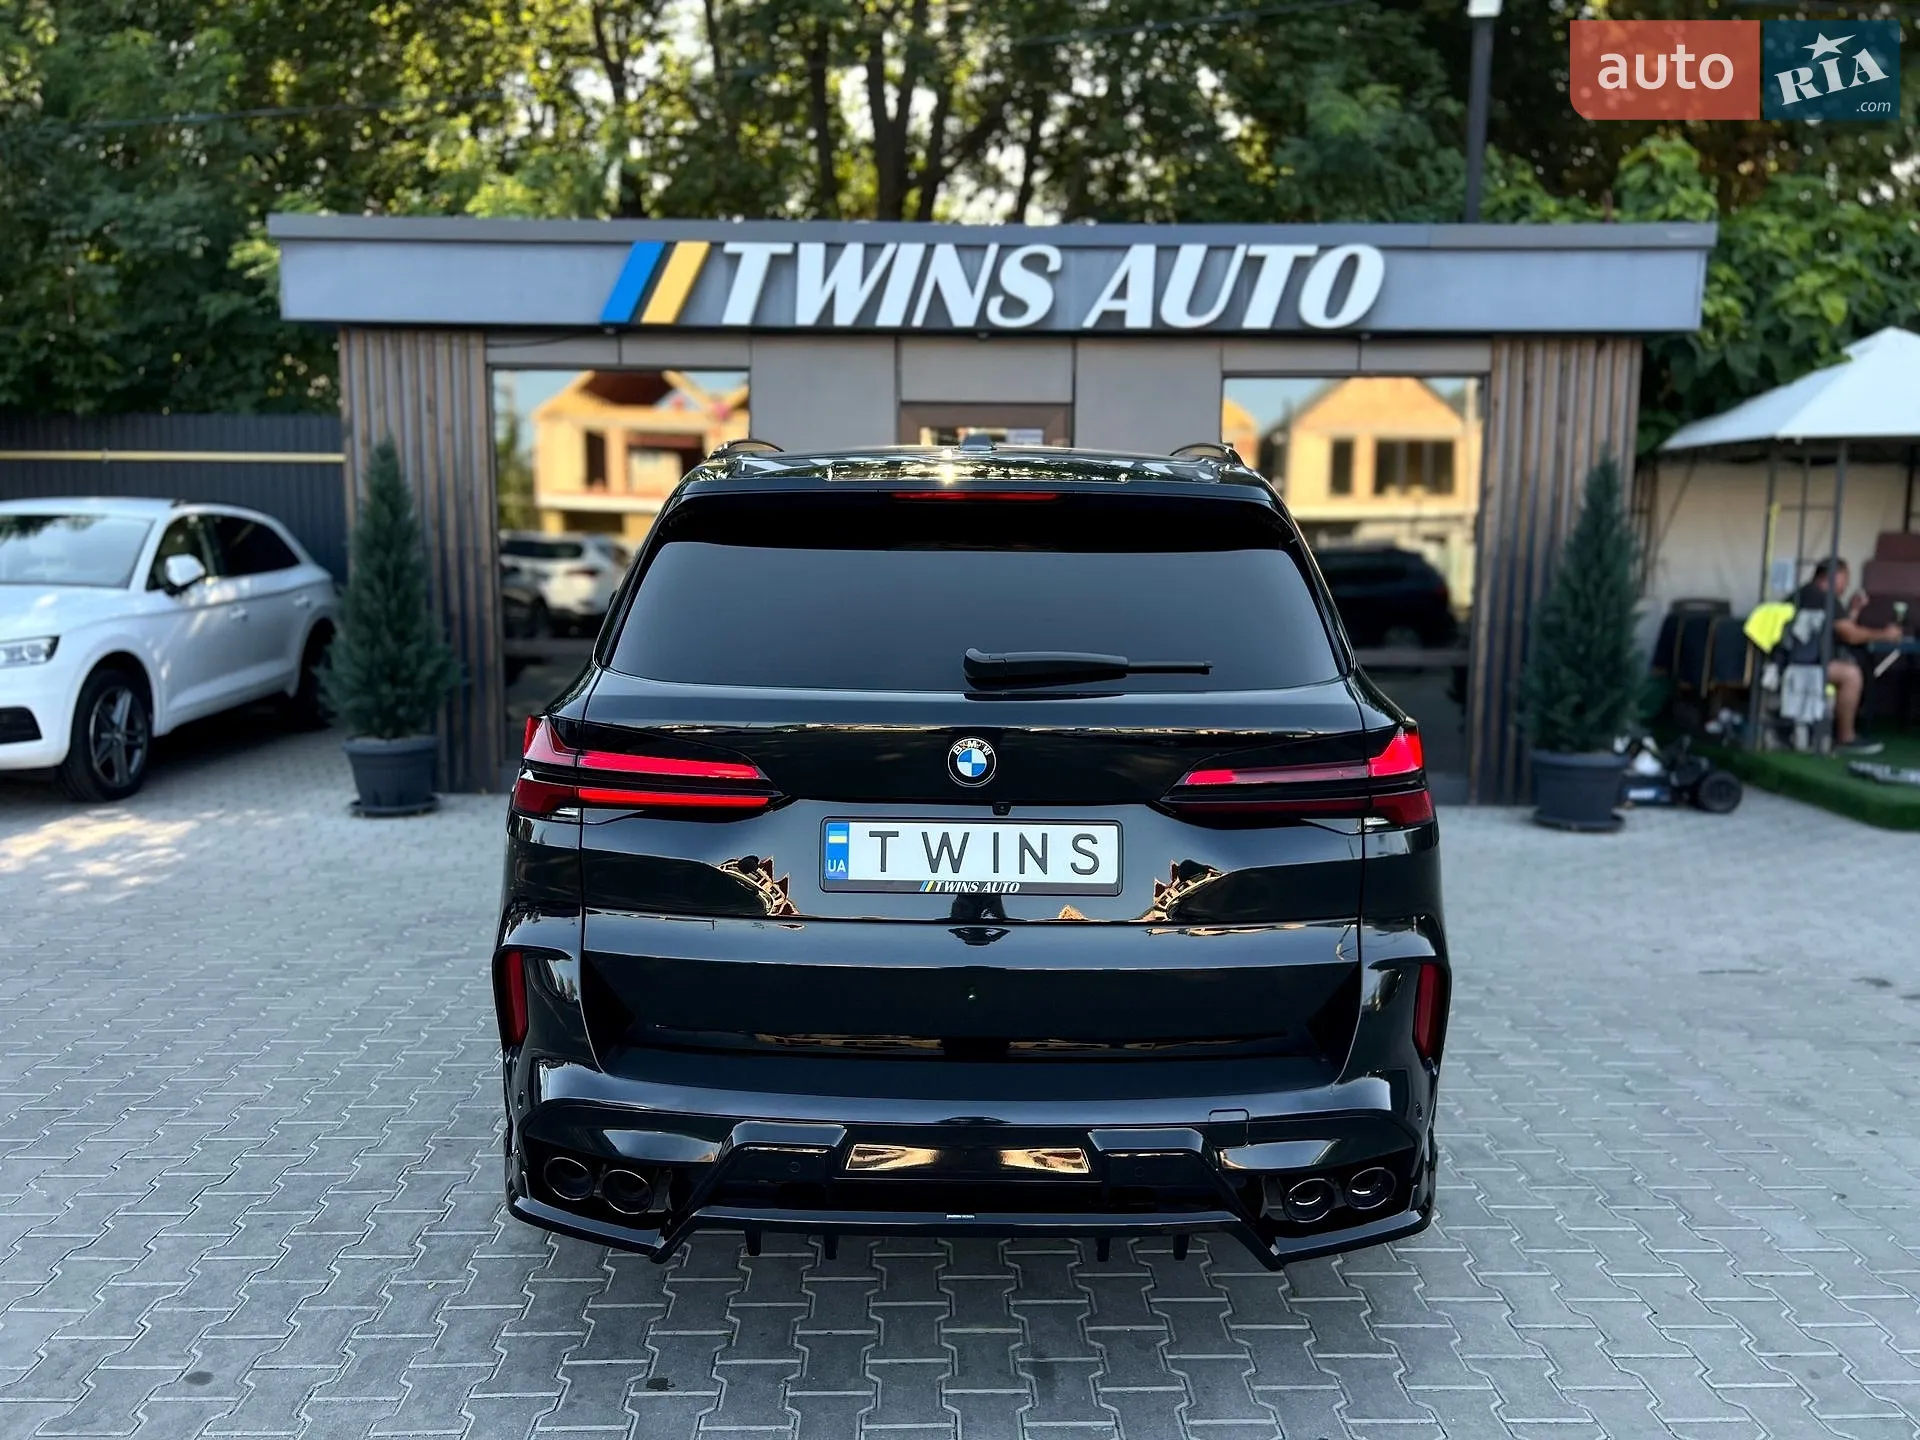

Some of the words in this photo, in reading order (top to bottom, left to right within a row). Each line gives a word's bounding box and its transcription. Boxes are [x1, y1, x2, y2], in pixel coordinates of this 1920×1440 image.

[722, 242, 1062, 328] TWINS
[1083, 244, 1385, 330] AUTO
[952, 739, 992, 756] BMW
[869, 830, 1100, 876] TWINS
[828, 859, 846, 873] UA
[935, 881, 978, 893] TWINS
[981, 882, 1020, 893] AUTO
